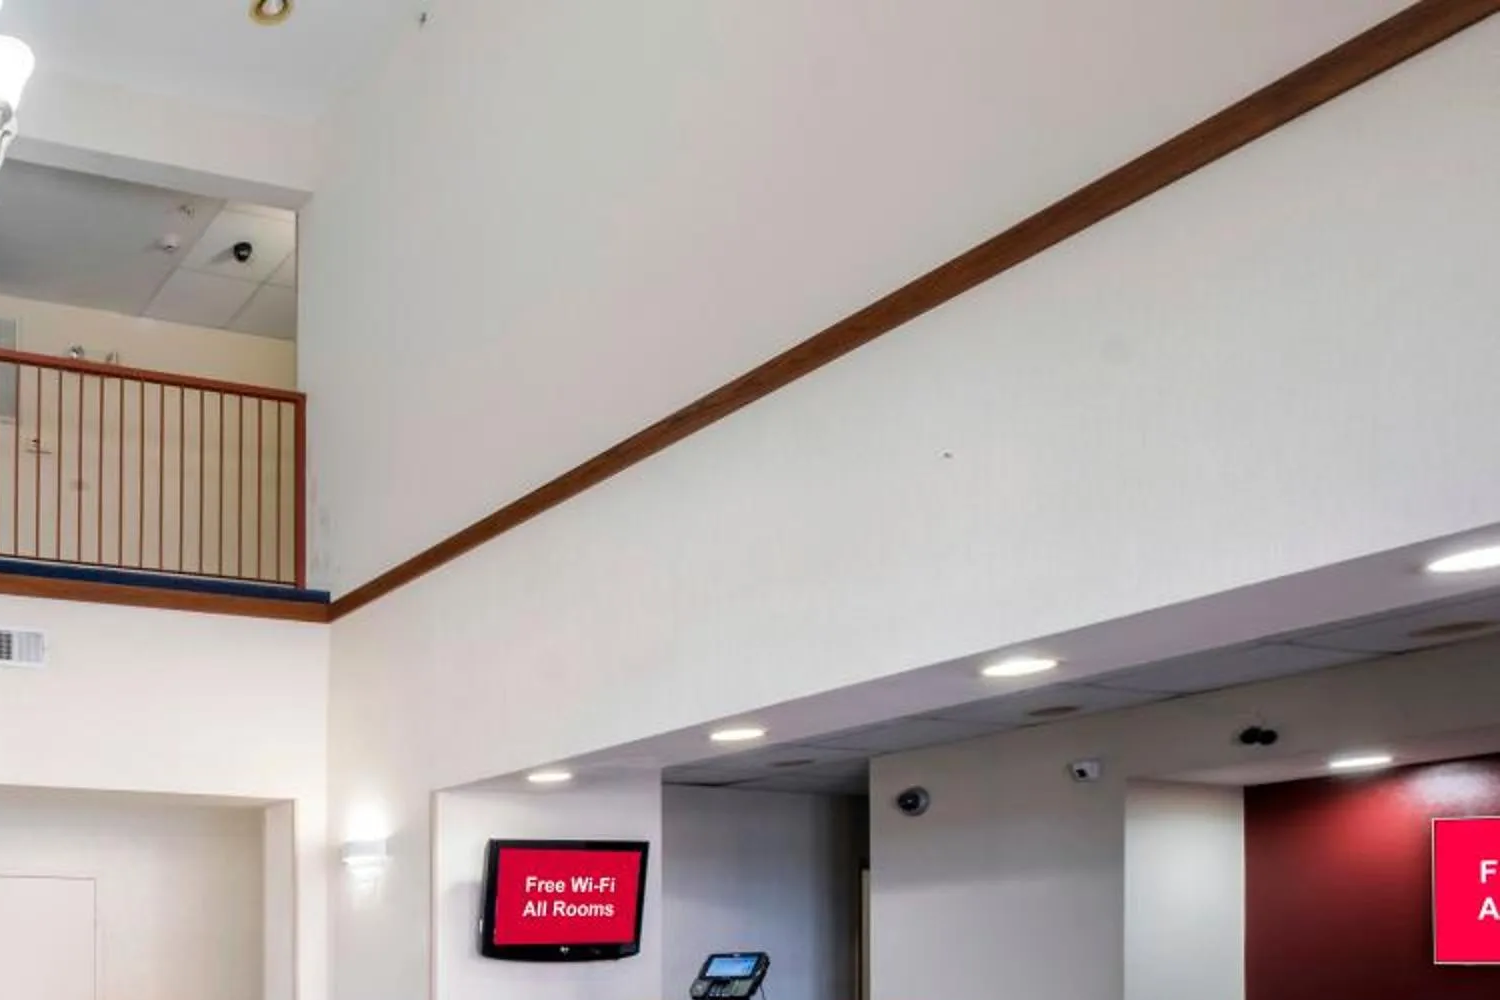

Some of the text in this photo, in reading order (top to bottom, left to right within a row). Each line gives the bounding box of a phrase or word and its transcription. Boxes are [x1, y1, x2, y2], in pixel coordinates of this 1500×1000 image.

[524, 876, 616, 893] Free Wi-Fi
[522, 901, 616, 918] All Rooms
